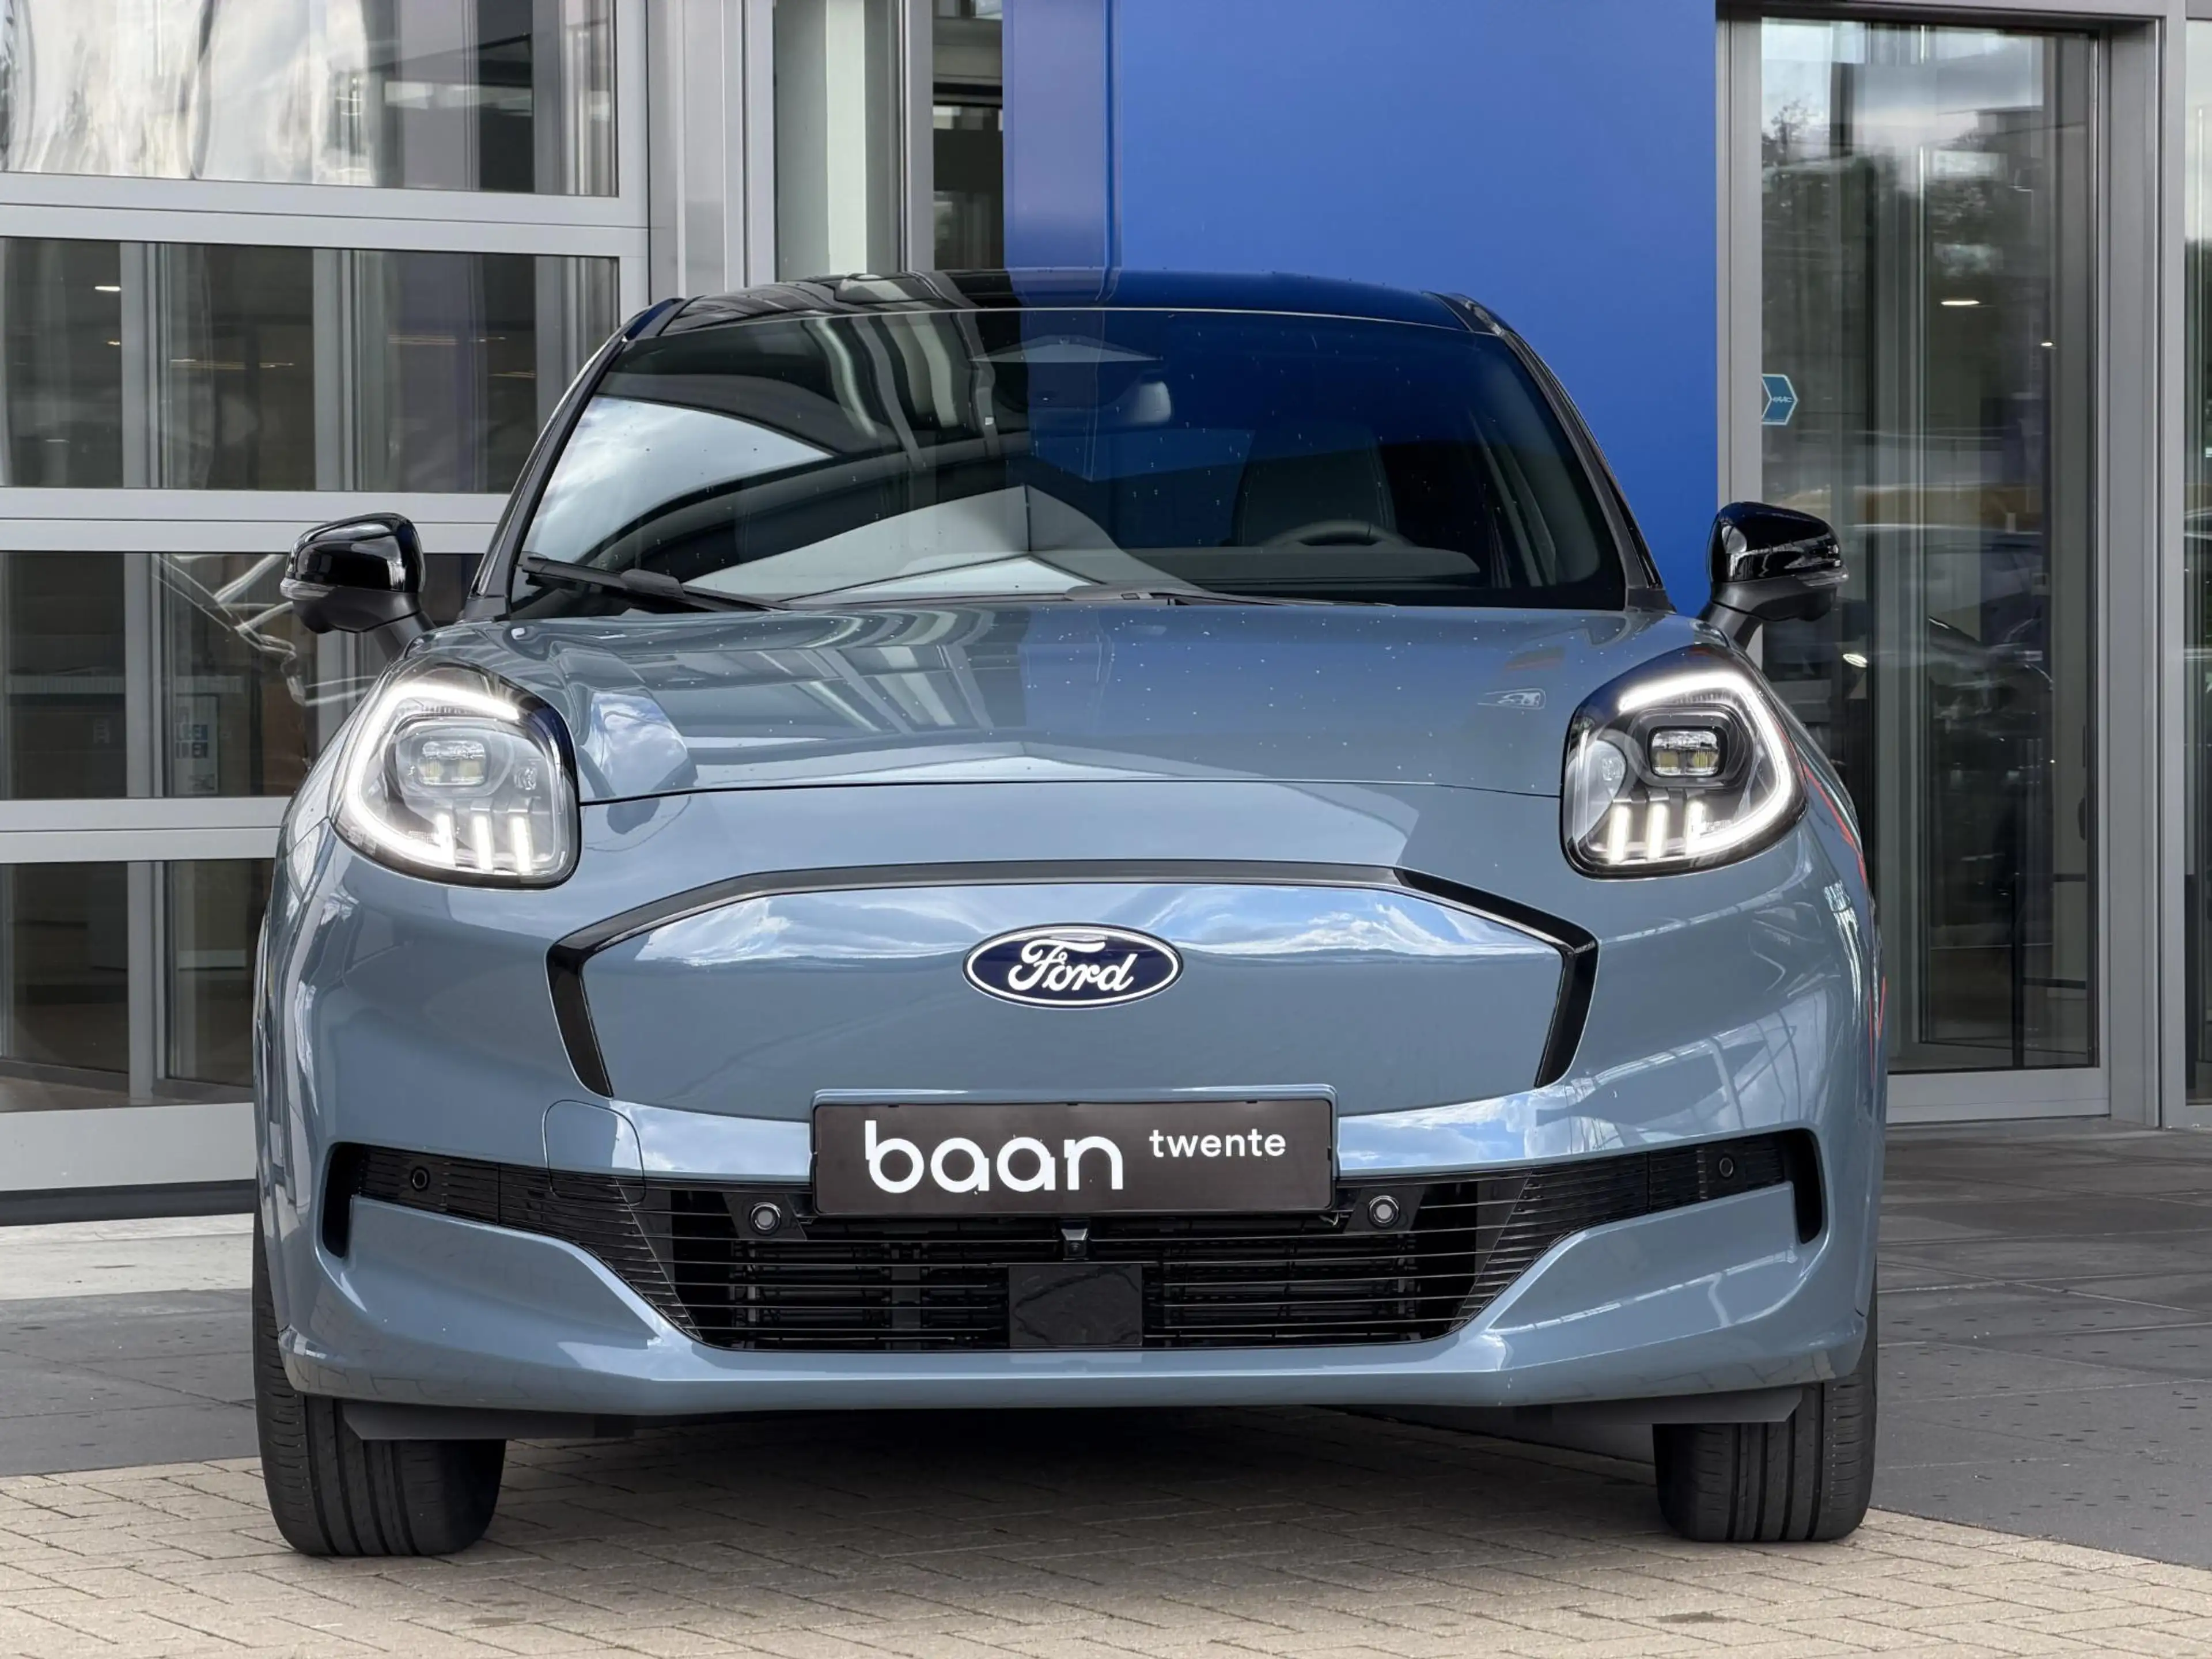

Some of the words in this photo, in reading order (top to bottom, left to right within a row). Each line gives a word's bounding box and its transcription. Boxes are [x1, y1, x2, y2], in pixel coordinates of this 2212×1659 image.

[1006, 937, 1138, 992] Ford
[865, 1120, 1123, 1194] baan
[1149, 1128, 1286, 1158] twente
